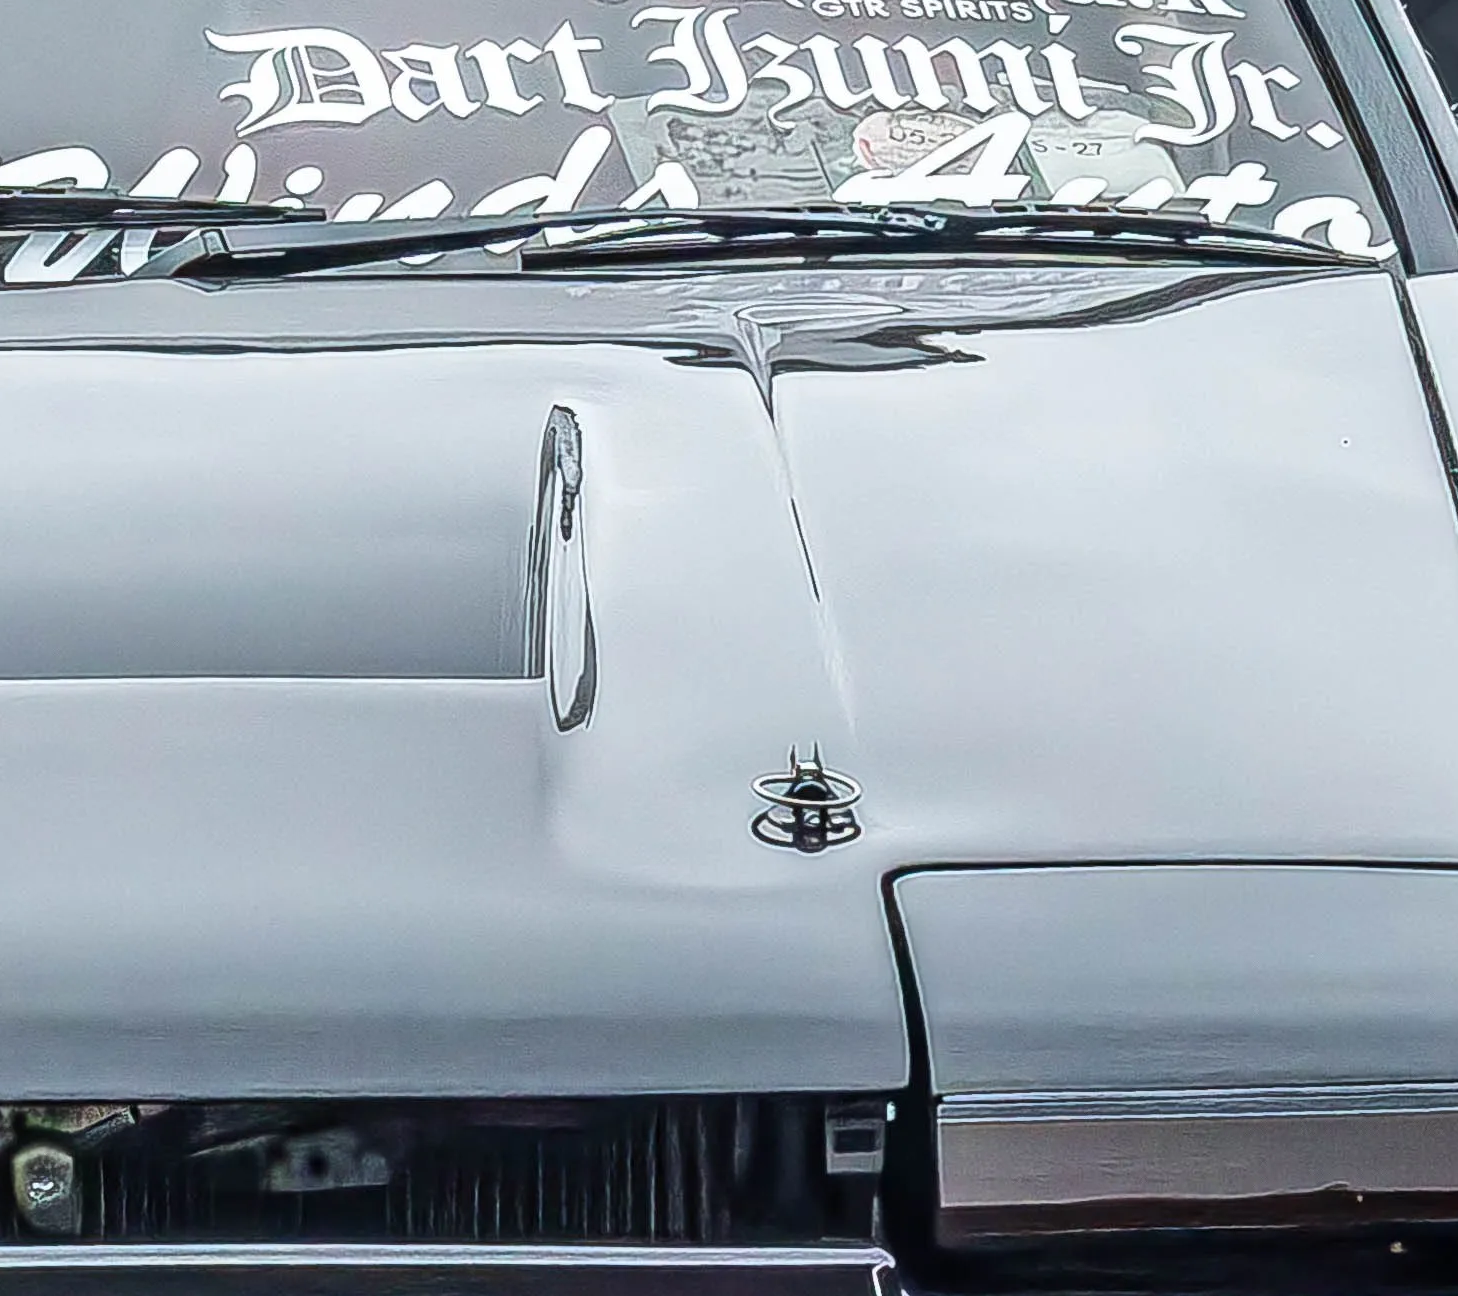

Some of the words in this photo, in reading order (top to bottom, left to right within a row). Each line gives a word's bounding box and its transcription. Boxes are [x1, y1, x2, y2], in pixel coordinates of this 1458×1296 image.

[203, 26, 617, 140] Dart
[630, 5, 1130, 131] Izumi
[1114, 23, 1345, 150] Jr.
